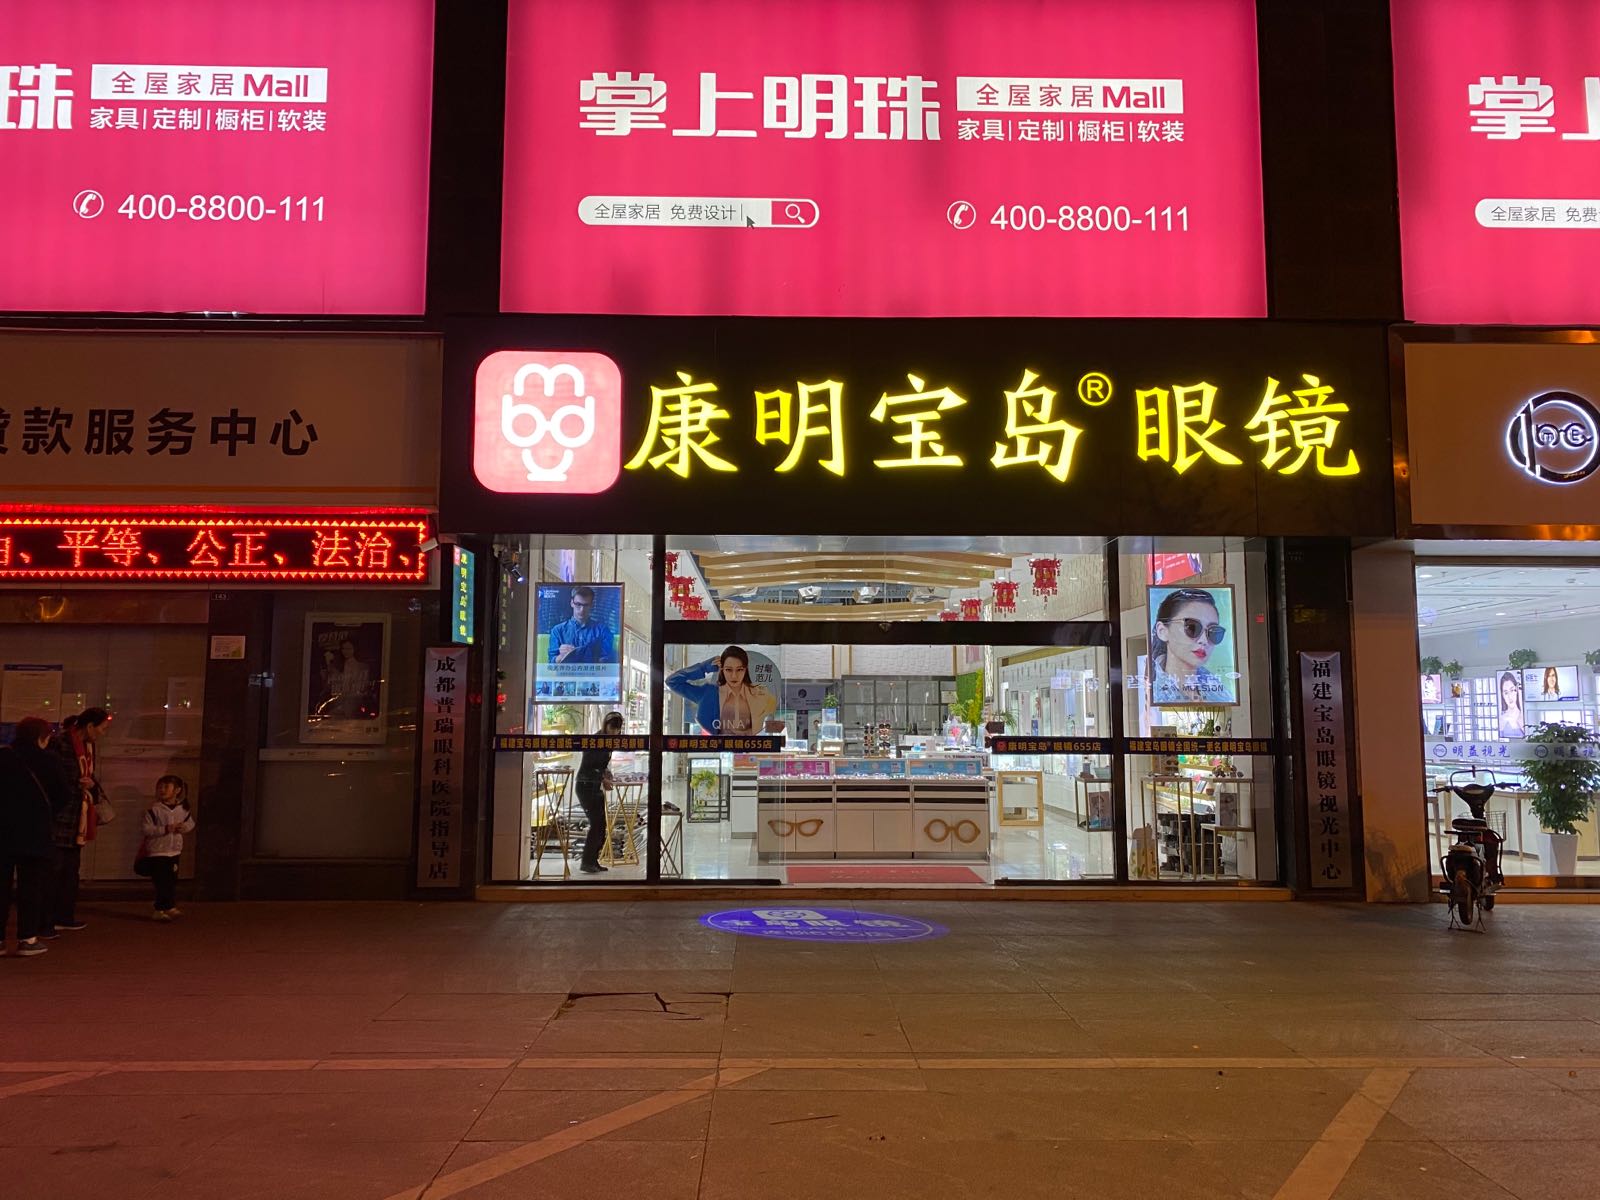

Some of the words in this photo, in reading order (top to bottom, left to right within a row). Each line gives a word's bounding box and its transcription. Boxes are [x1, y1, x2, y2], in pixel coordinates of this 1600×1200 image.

[0, 63, 74, 130] 珠
[579, 71, 942, 140] 掌上明珠
[117, 193, 325, 222] 400-8800-111
[594, 203, 661, 221] 全屋家居
[670, 203, 737, 222] 免费设计
[990, 205, 1189, 233] 400-8800-111
[1490, 206, 1557, 223] 全屋家居
[1566, 206, 1600, 223] 免费
[0, 406, 319, 457] 款服务中心
[428, 655, 457, 881] 成都普瑞眼科医院指导店
[1311, 659, 1342, 881] 福建宝岛眼镜视光中心
[1452, 744, 1511, 758] 明益视光
